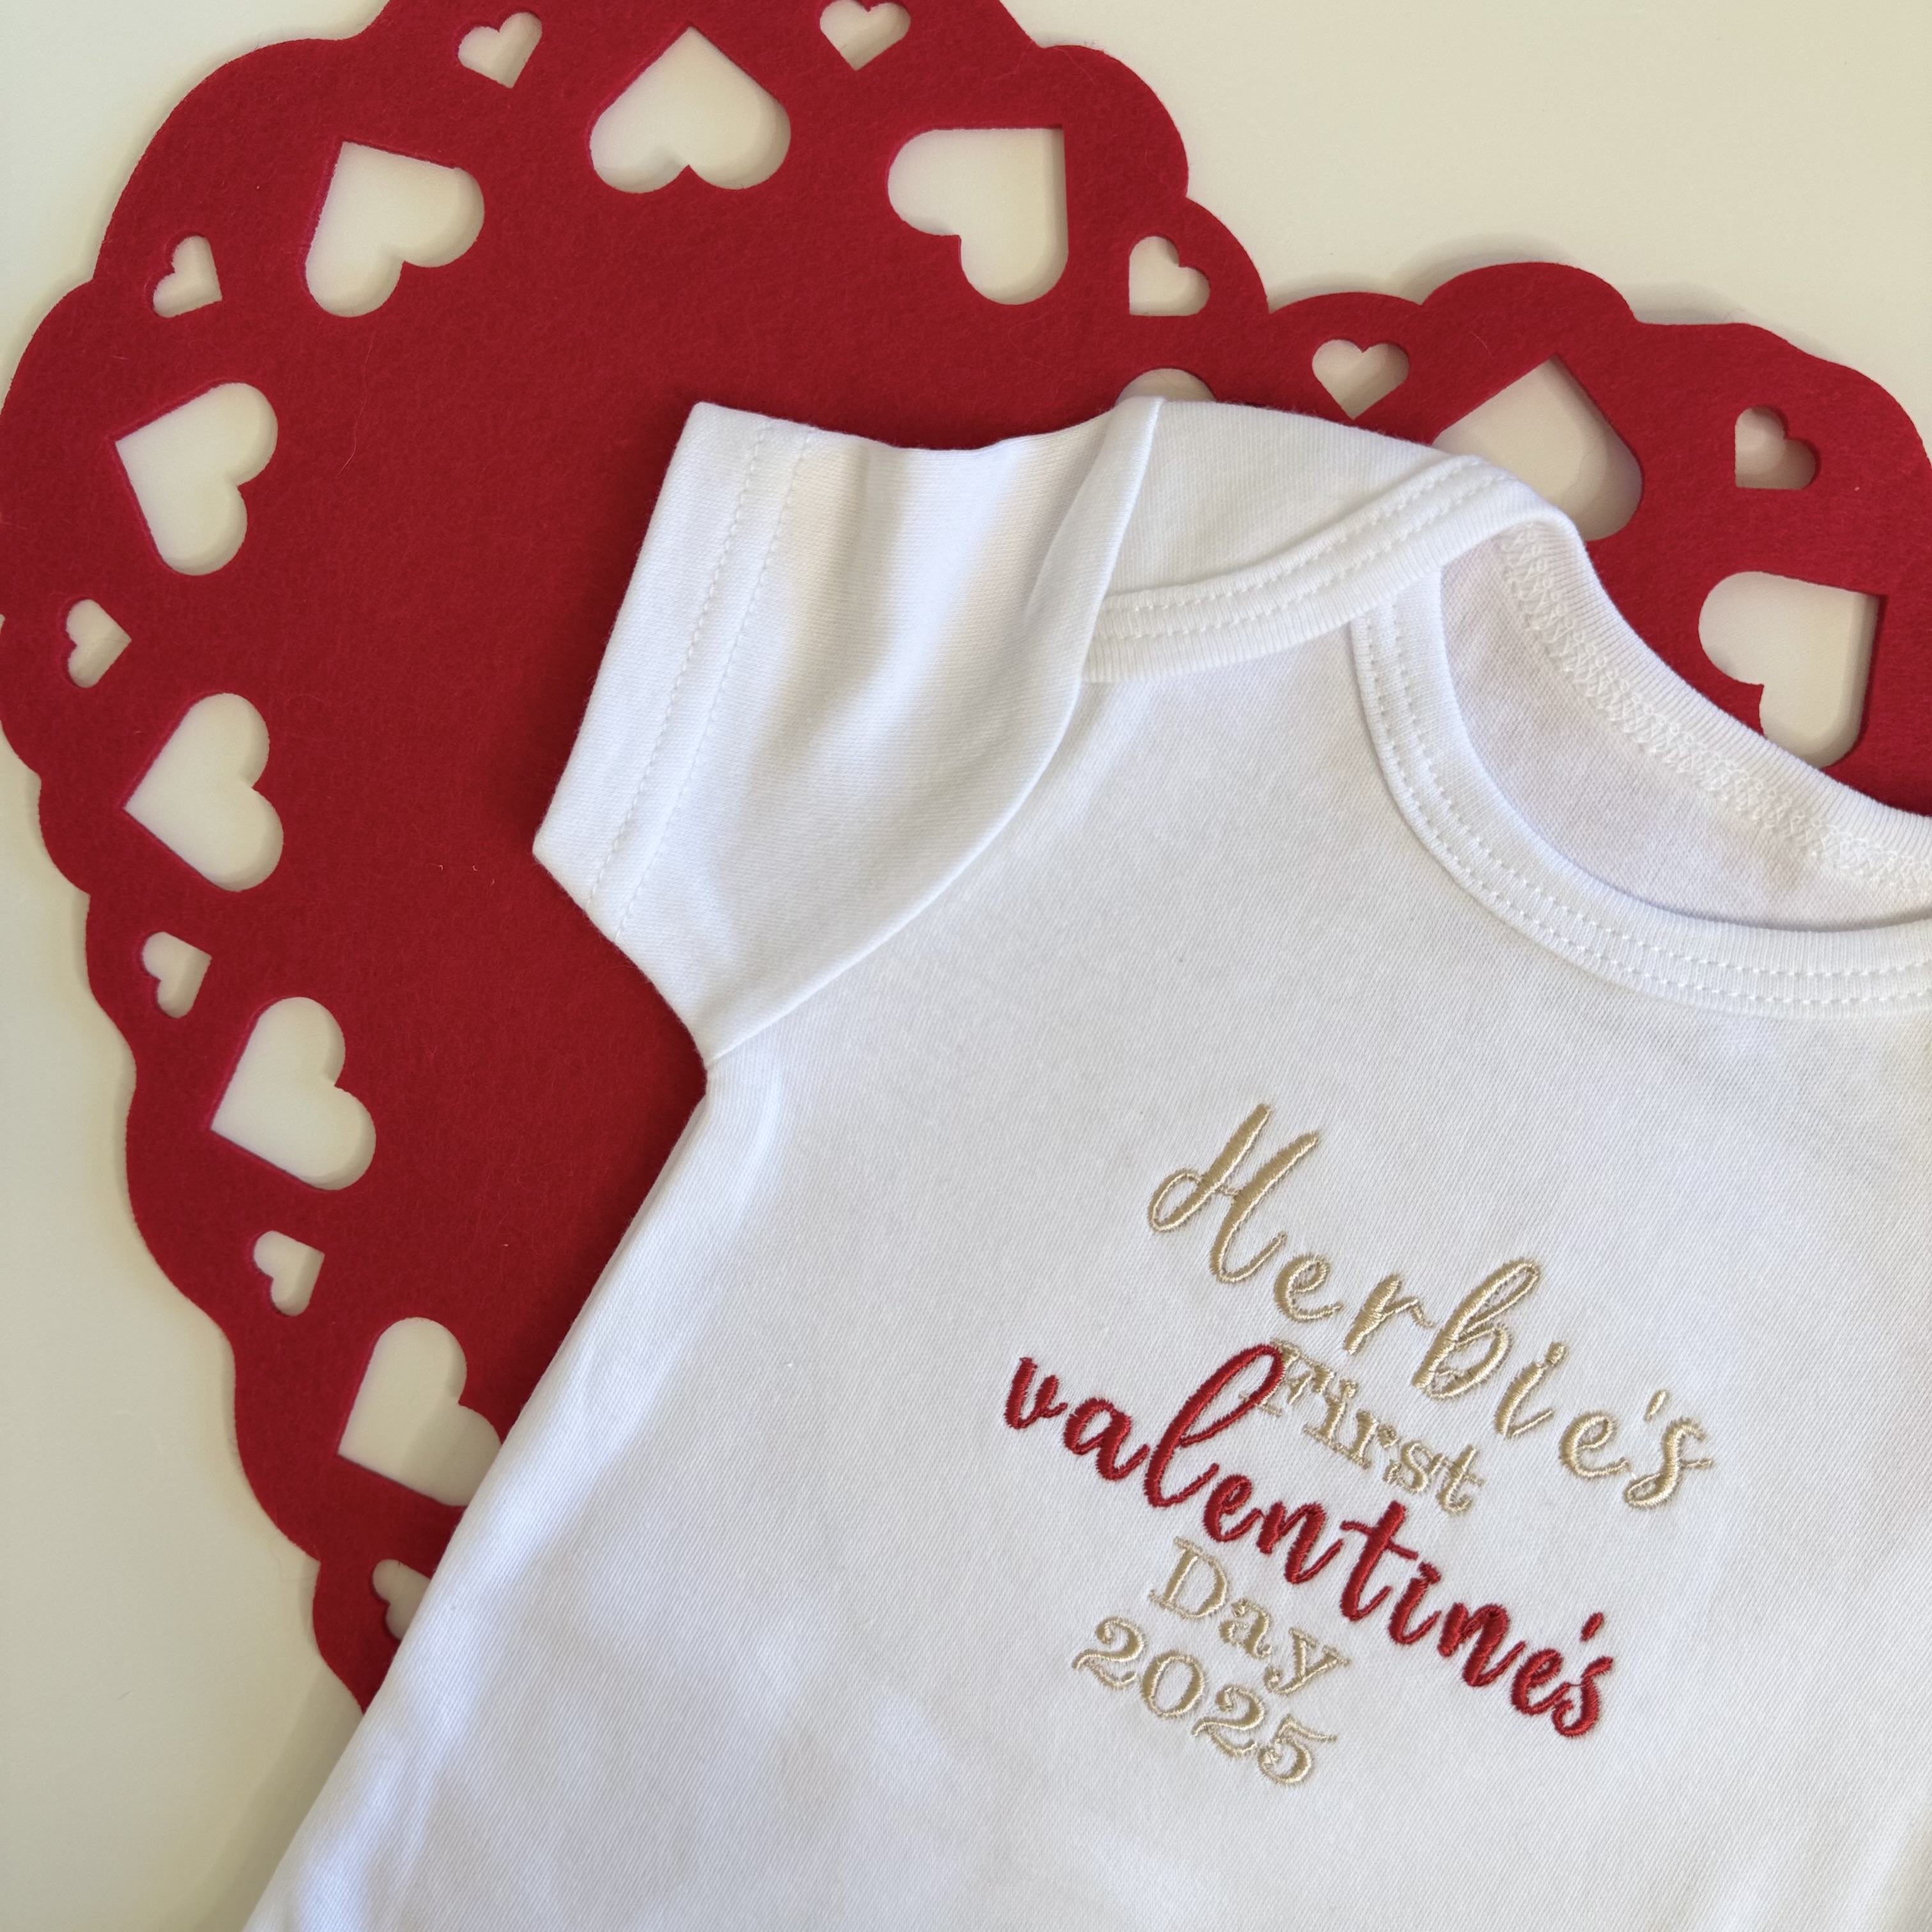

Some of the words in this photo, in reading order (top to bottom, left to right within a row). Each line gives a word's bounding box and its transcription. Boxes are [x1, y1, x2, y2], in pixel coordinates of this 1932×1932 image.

[1148, 1103, 1715, 1509] Herbie's
[1240, 1338, 1483, 1515] First
[1071, 1617, 1337, 1786] 2025
[1148, 1538, 1351, 1695] Day
